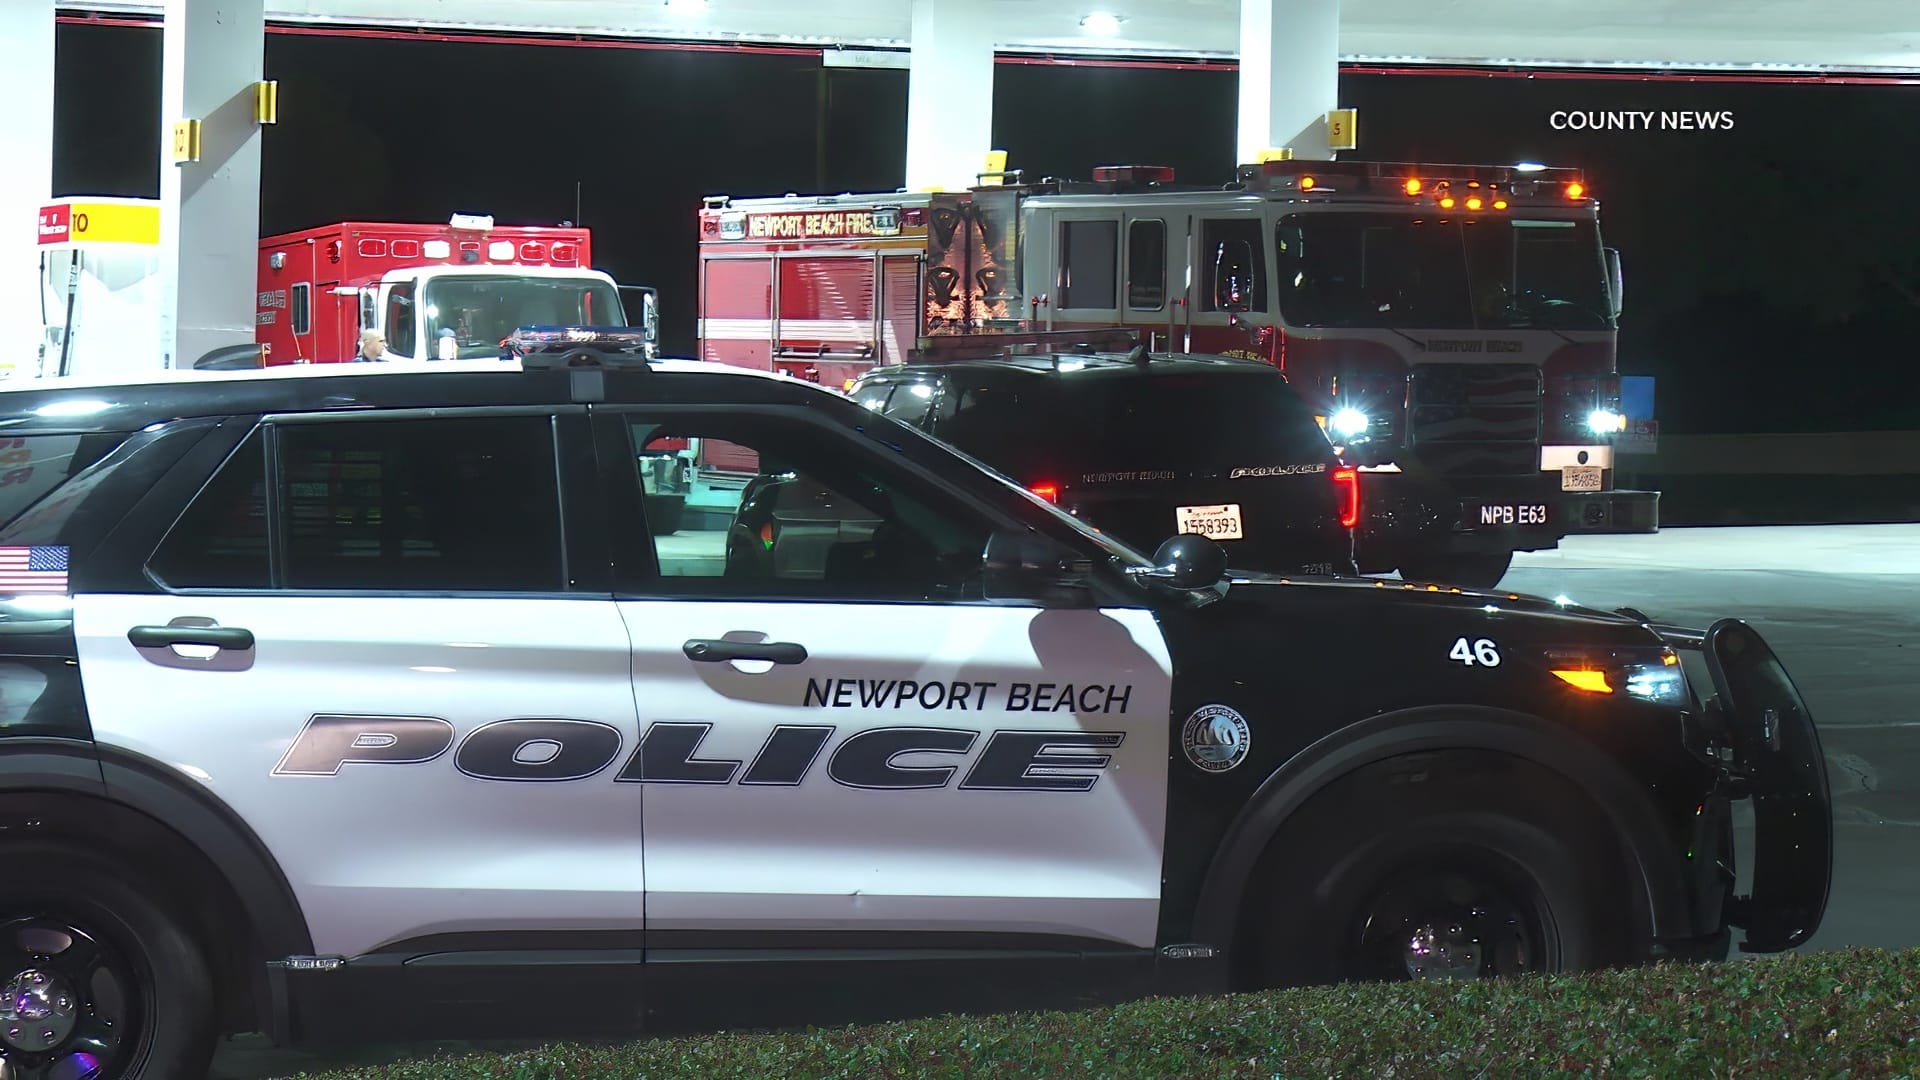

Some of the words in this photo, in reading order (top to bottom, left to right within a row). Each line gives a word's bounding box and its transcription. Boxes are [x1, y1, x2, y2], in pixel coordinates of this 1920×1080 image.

[750, 214, 802, 237] NEWPORT
[805, 212, 844, 236] BEACH
[846, 211, 874, 235] FIRE
[1183, 517, 1238, 535] 1558393
[1480, 505, 1514, 525] NPB
[1518, 504, 1547, 525] E63
[1449, 637, 1500, 668] 46
[802, 677, 997, 712] NEWPORT
[1005, 683, 1133, 715] BEACH
[270, 712, 1127, 792] POLICE
